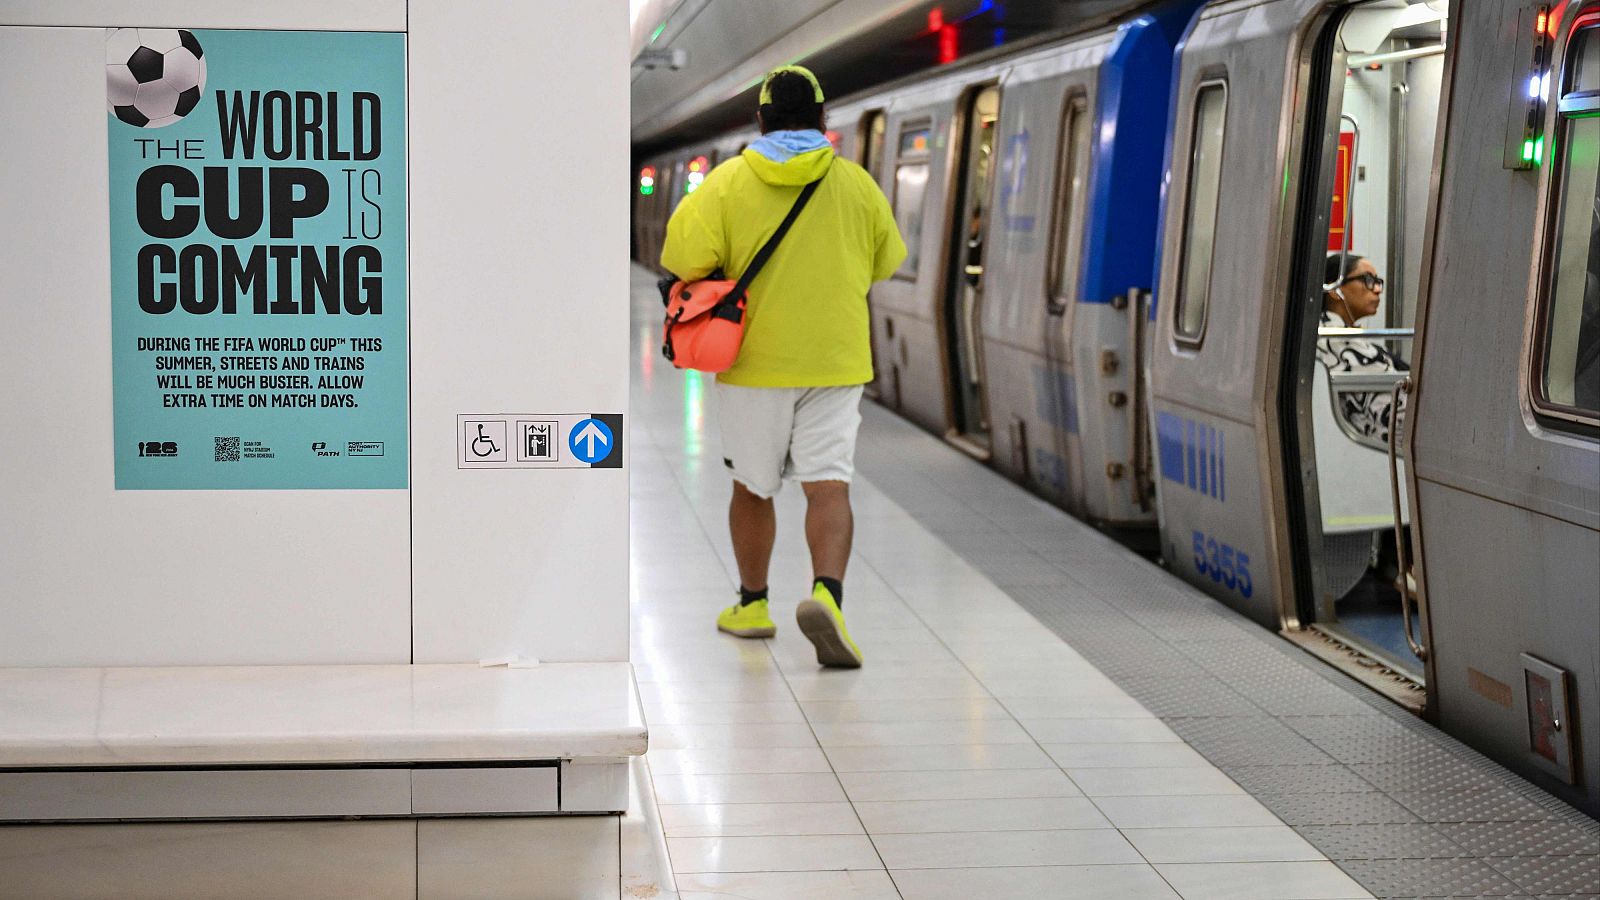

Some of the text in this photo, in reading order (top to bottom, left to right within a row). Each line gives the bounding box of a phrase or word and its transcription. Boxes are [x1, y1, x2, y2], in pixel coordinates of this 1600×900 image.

[134, 90, 381, 161] THE WORLD
[136, 165, 382, 239] CUP IS
[138, 244, 382, 315] COMING
[138, 337, 190, 352] DURING
[194, 337, 220, 352] THE
[224, 337, 254, 352] FIFA
[258, 337, 305, 352] WORLD
[350, 337, 382, 352] THIS
[156, 356, 364, 371] SUMMER, STREETS AND TRAINS
[157, 375, 364, 389] WILL BE MUCH BUSIER. ALLOW
[163, 393, 358, 408] EXTRA TIME ON MATCH DAYS.
[1192, 530, 1252, 598] 5355
